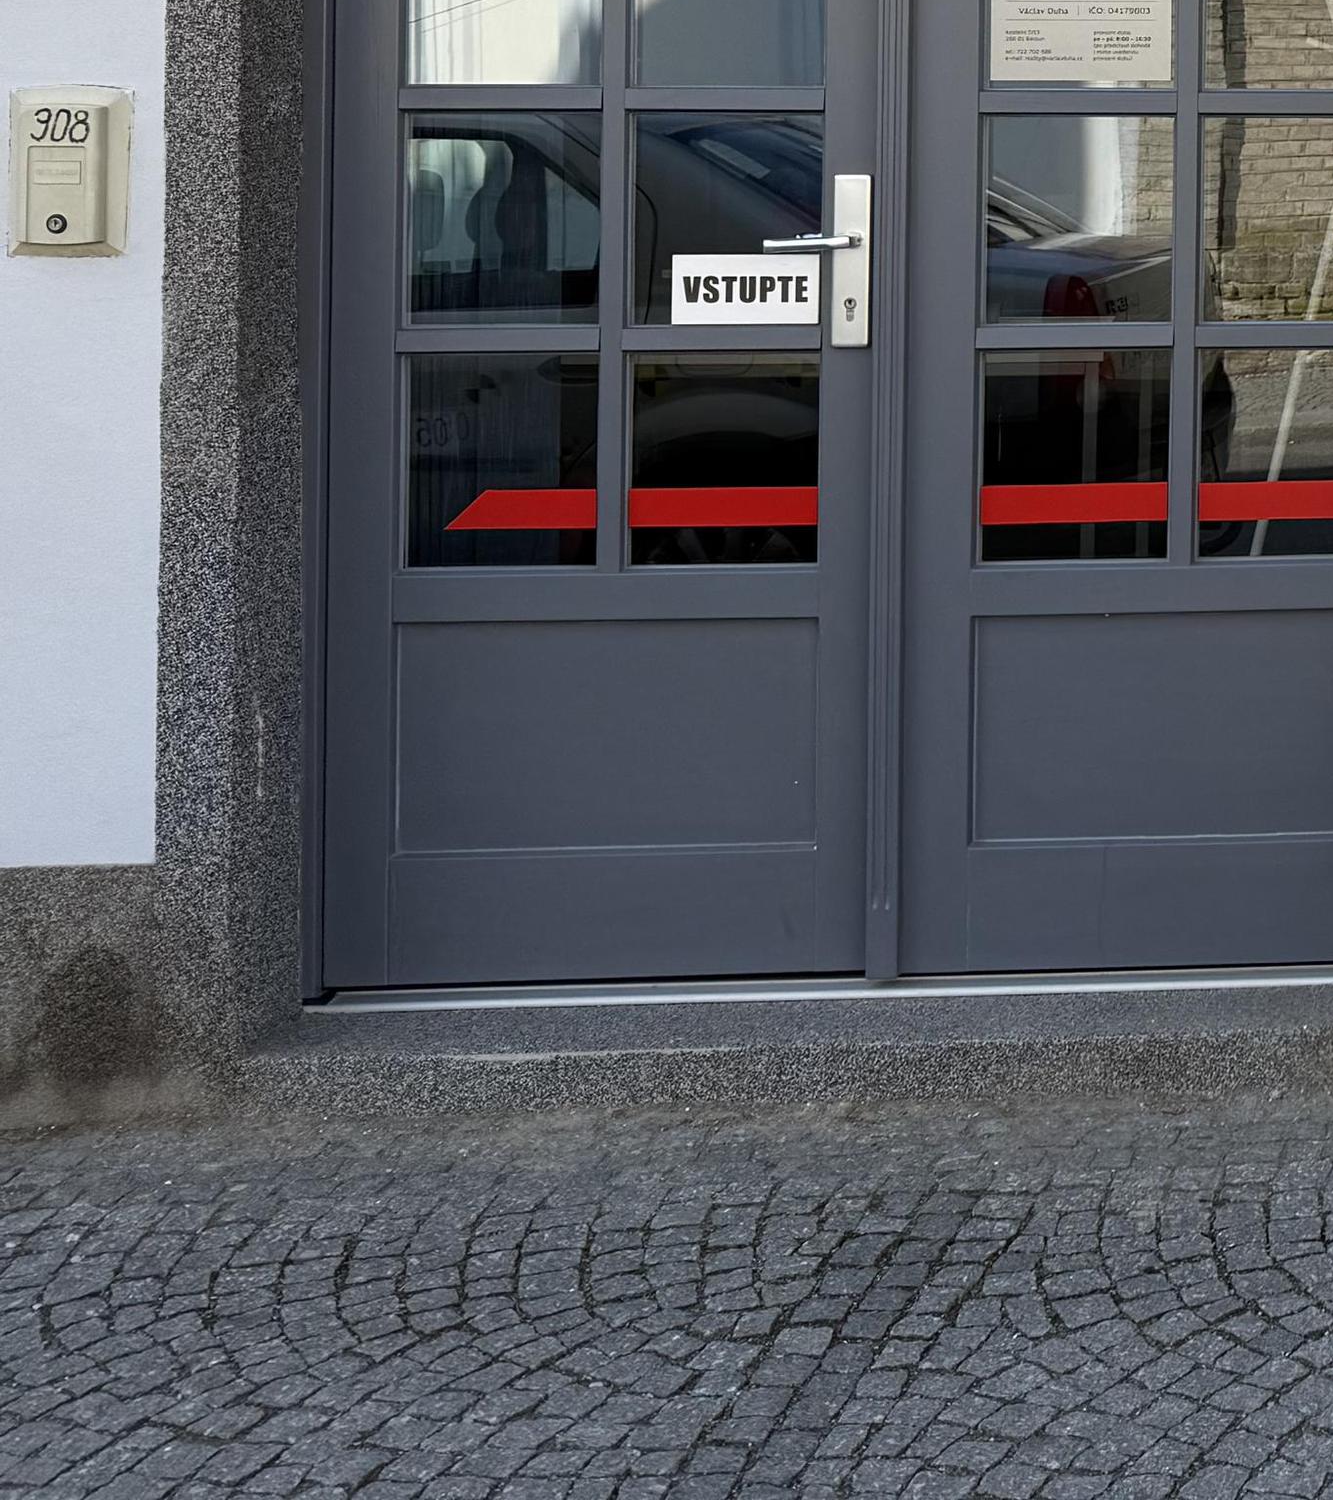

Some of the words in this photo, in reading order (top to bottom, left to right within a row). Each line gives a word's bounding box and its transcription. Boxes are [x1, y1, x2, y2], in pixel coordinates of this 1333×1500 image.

[1018, 7, 1045, 15] Václav
[1047, 7, 1069, 15] Duha
[30, 107, 91, 143] 908
[682, 275, 809, 304] VSTUPTE
